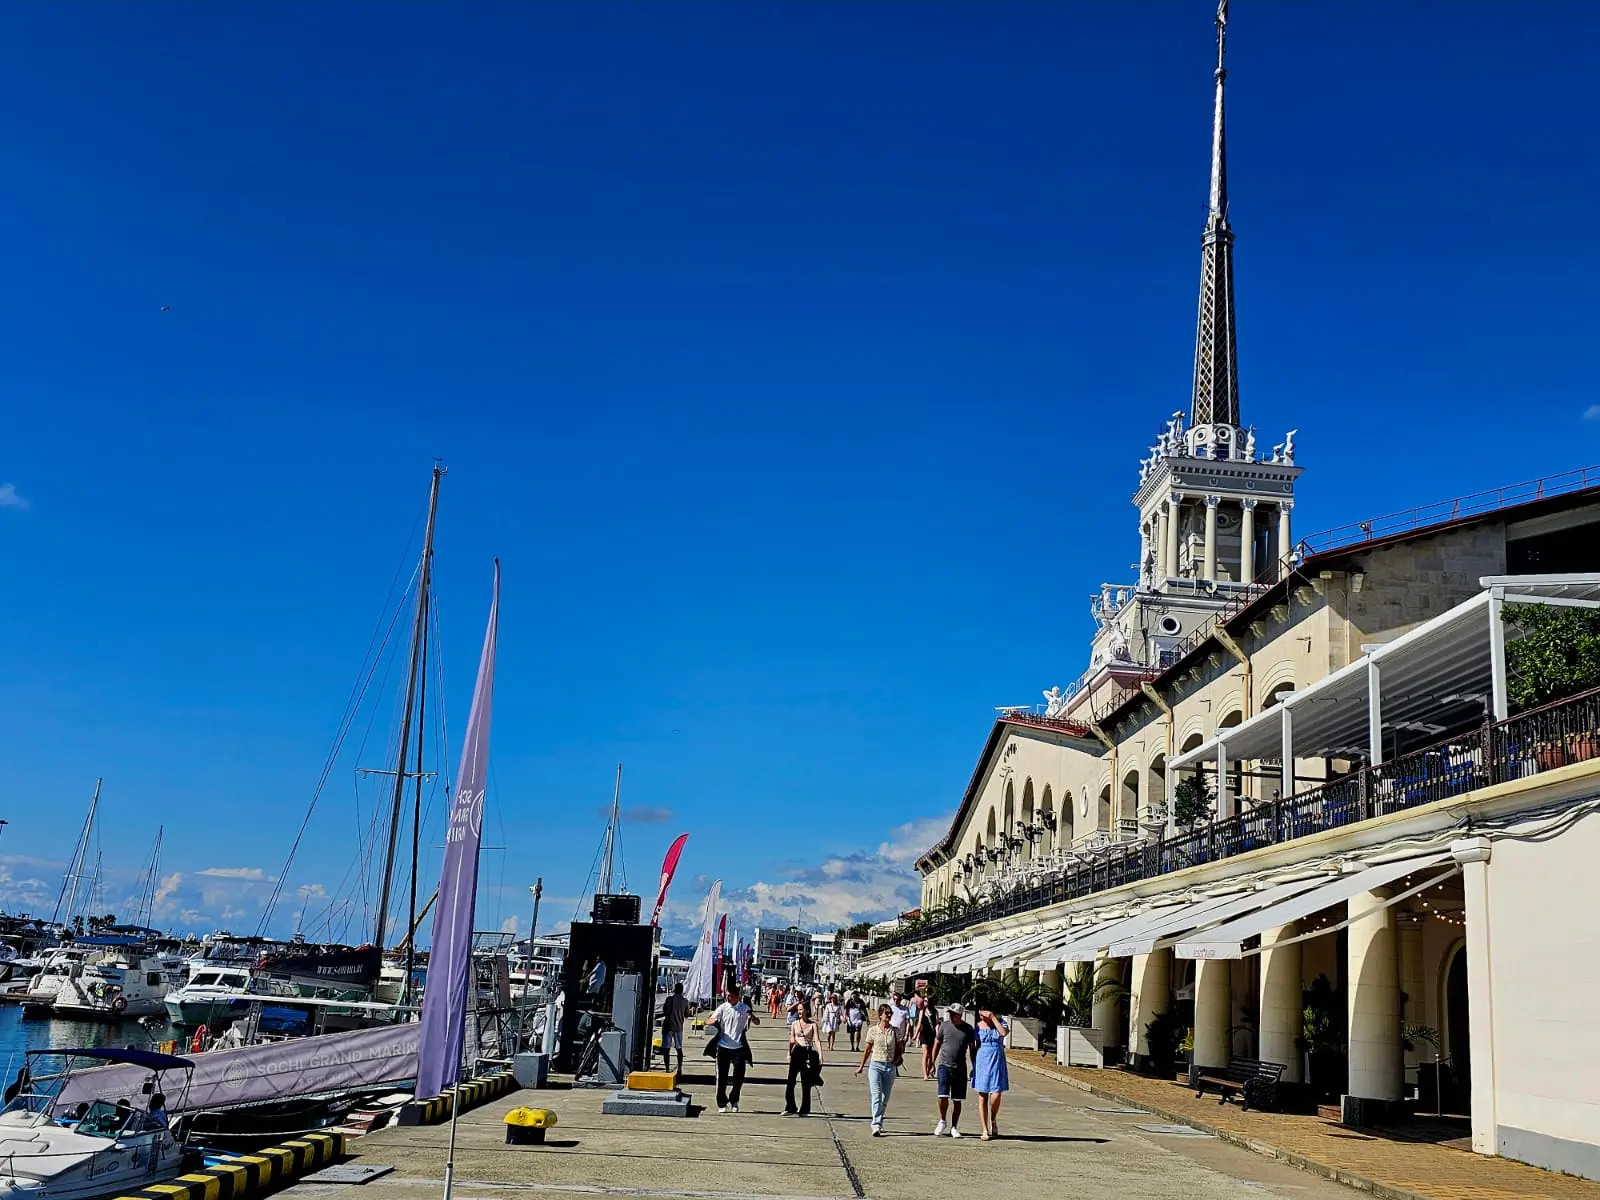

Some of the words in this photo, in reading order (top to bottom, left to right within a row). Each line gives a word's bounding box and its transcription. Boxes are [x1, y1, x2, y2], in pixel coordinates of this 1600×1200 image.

[256, 1059, 303, 1077] SOCHI
[310, 1050, 363, 1068] GRAND
[369, 1041, 419, 1059] MARIN
